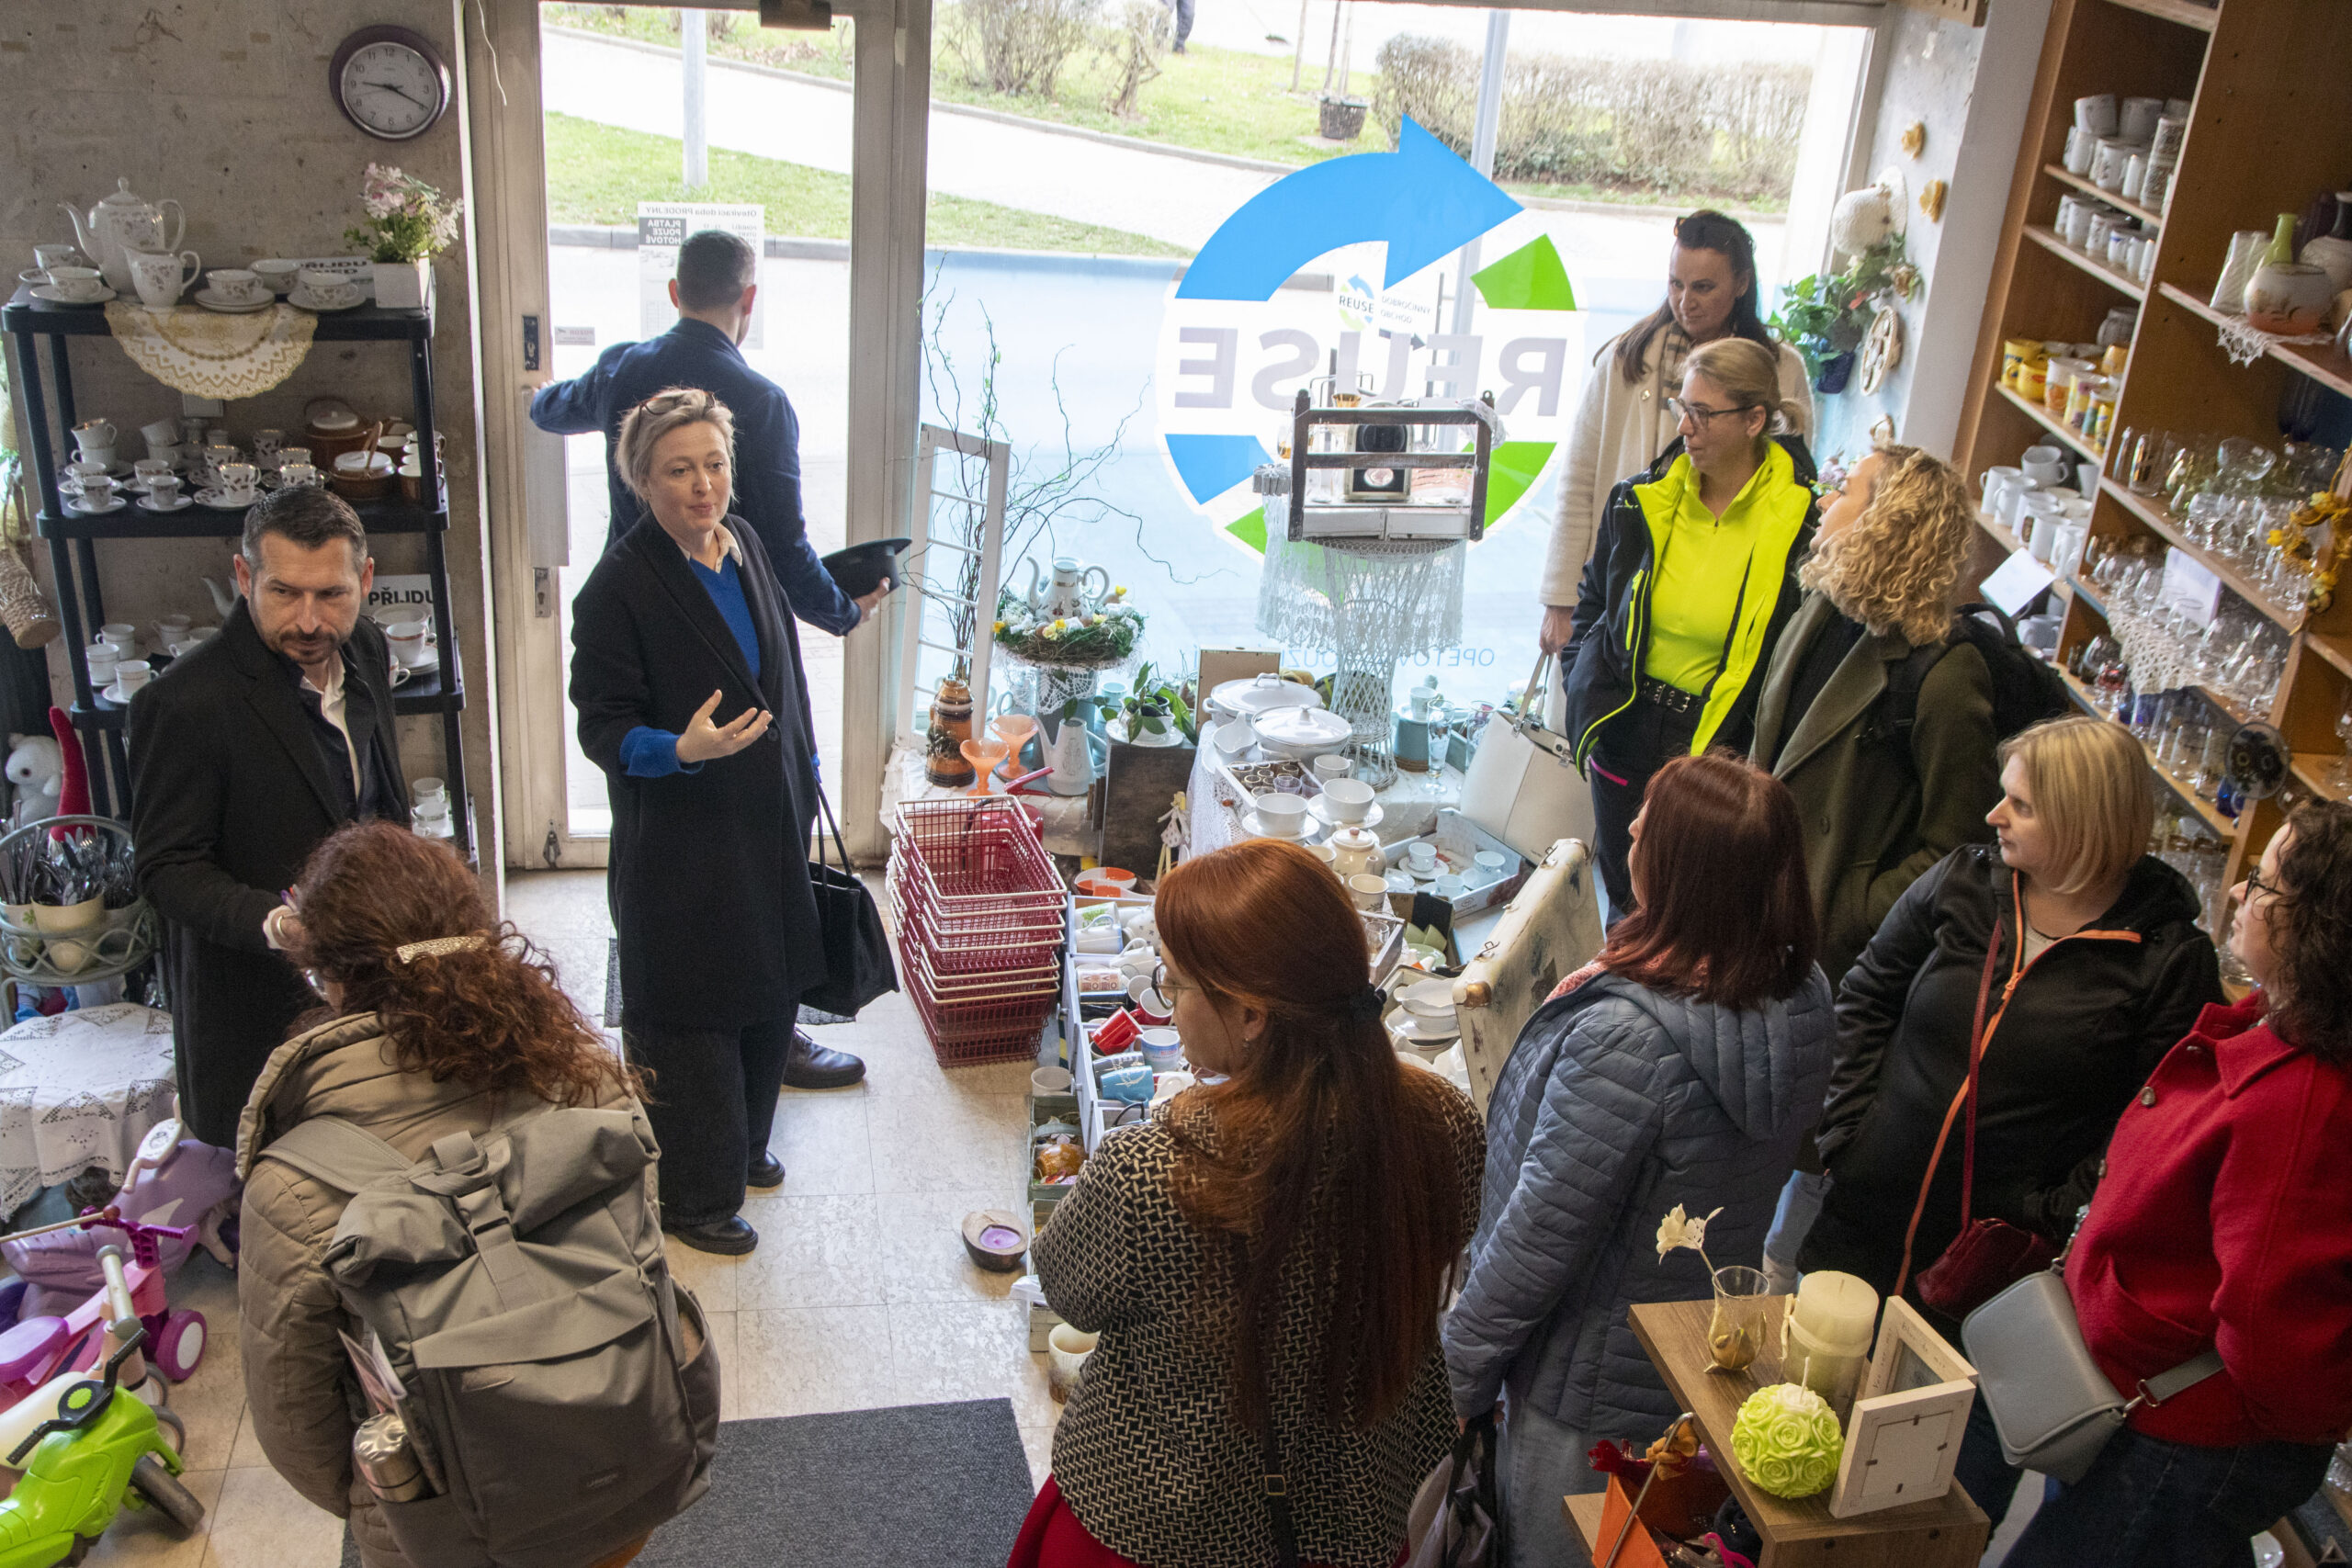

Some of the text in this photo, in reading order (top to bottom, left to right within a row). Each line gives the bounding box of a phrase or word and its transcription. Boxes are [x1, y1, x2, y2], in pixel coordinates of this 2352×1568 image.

[368, 51, 376, 61] 11
[385, 48, 395, 57] 12
[355, 64, 365, 73] 10
[350, 80, 356, 88] 9
[1339, 295, 1374, 313] REUSE
